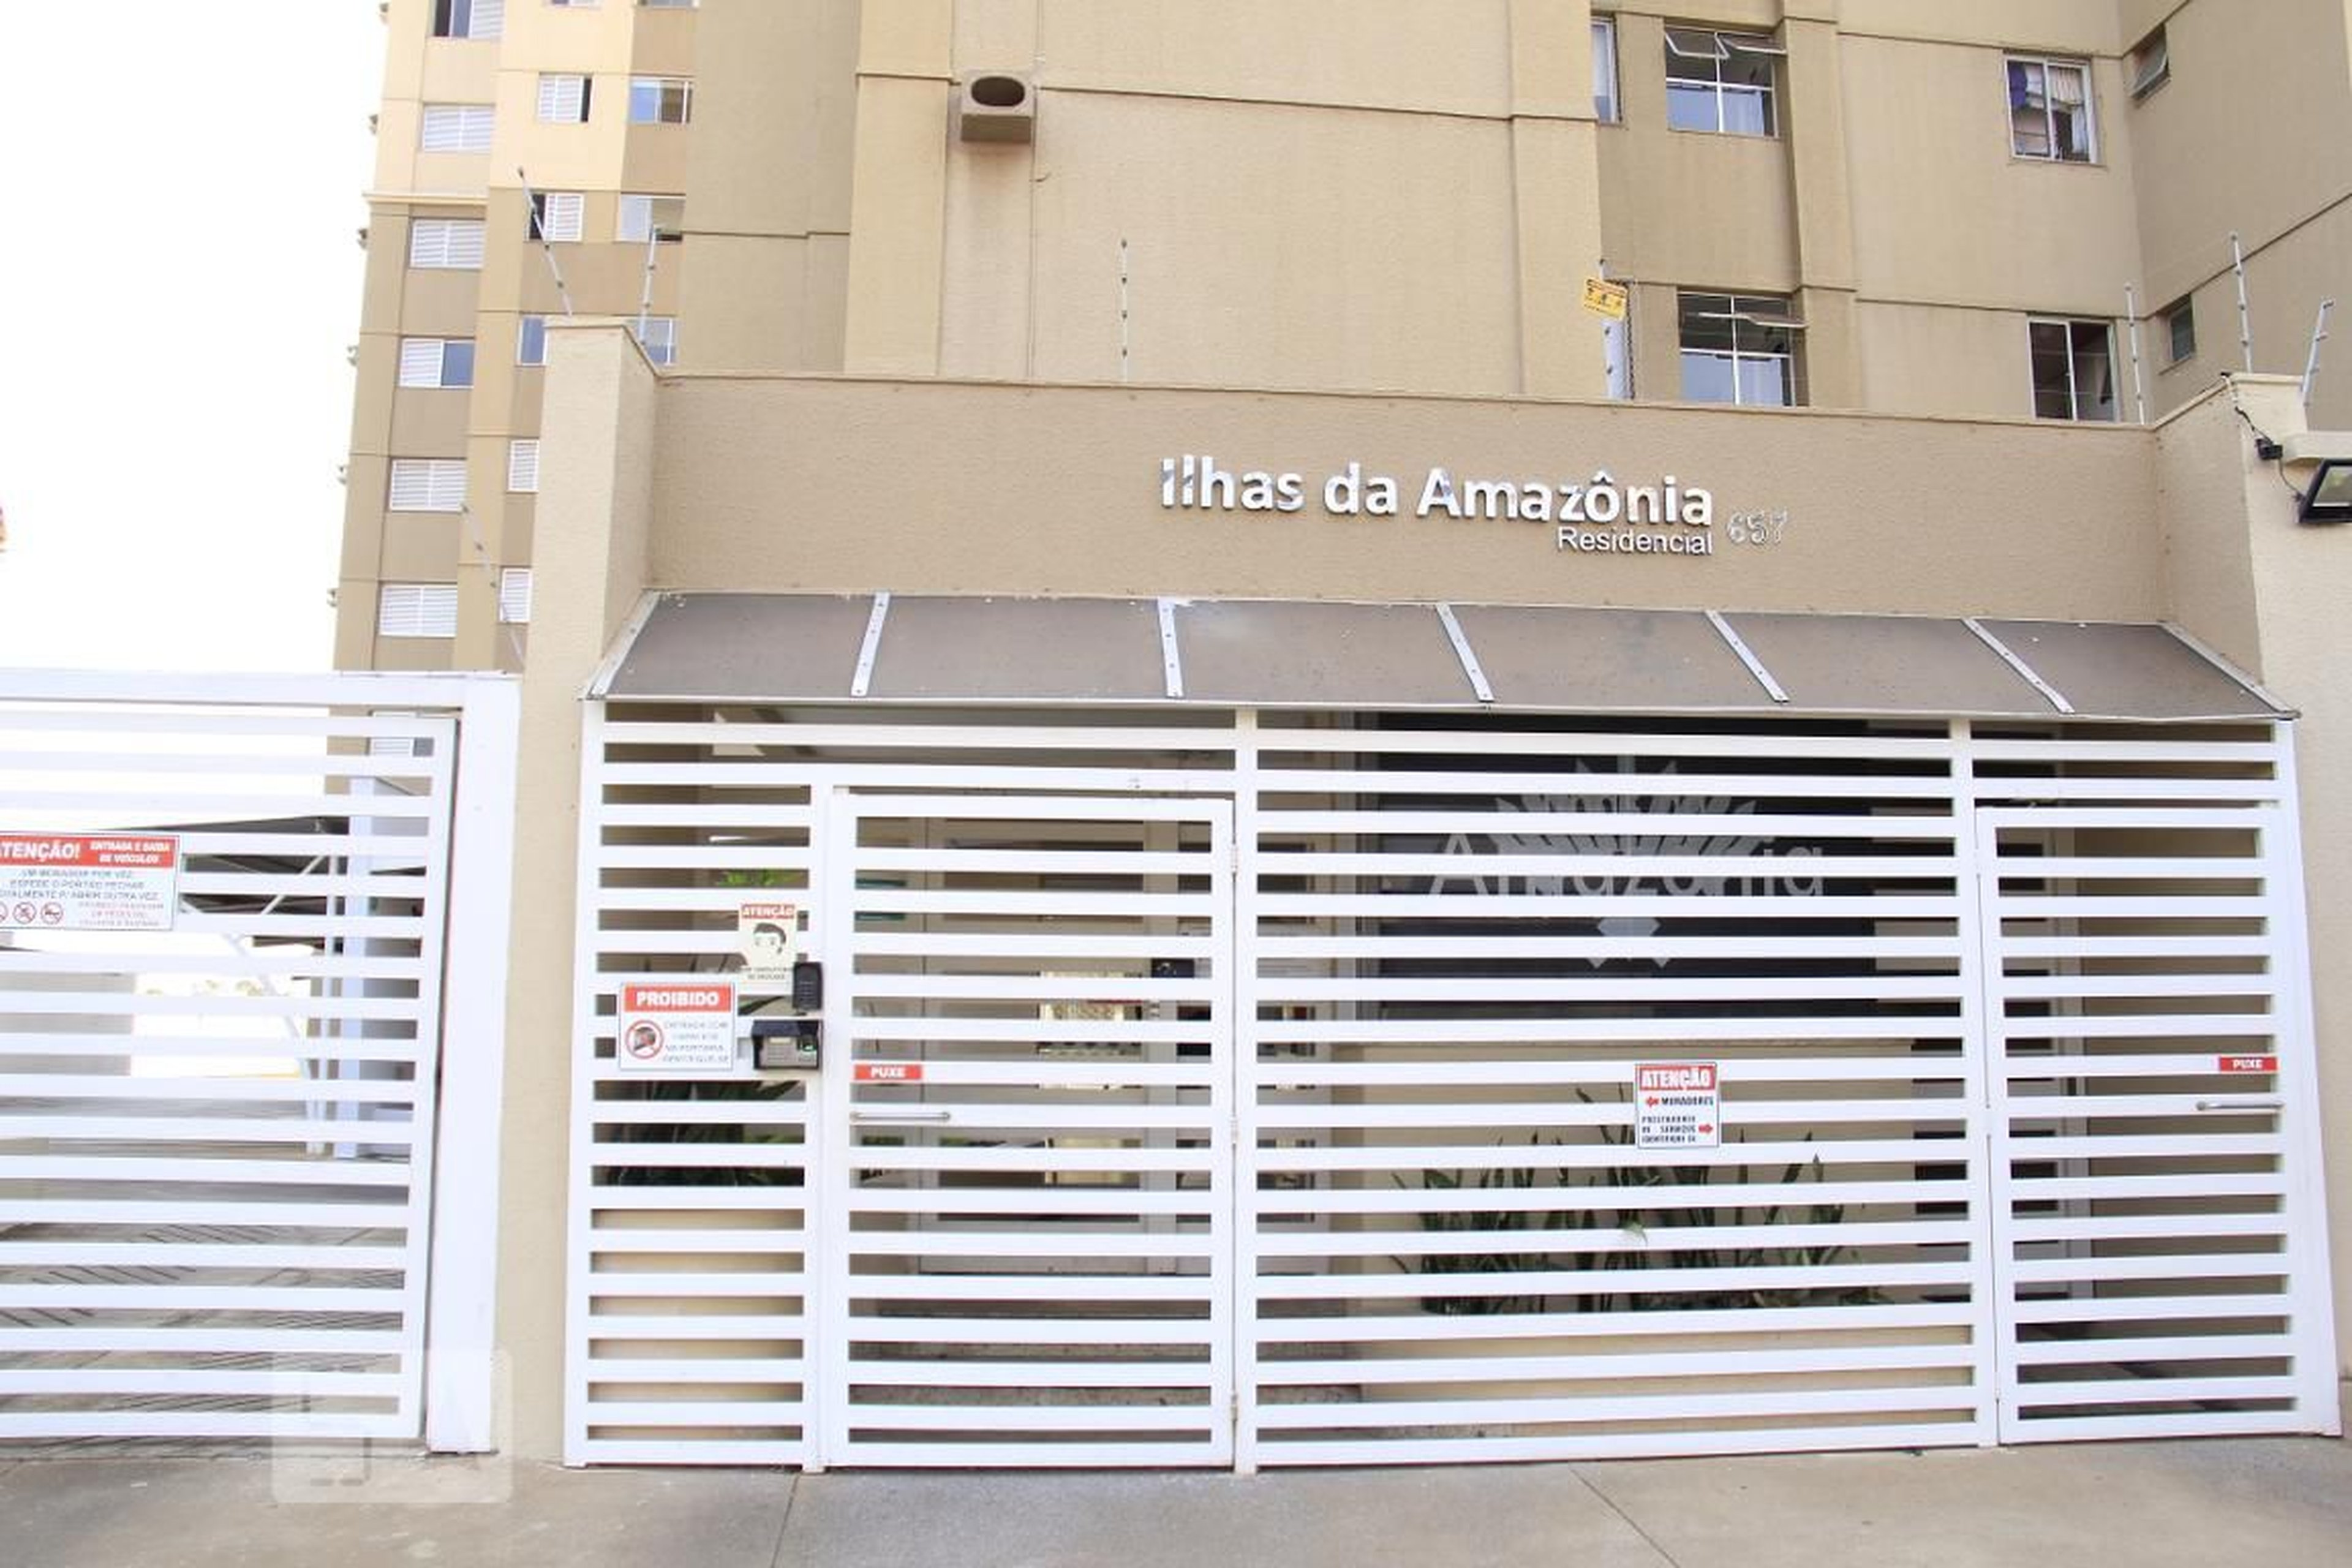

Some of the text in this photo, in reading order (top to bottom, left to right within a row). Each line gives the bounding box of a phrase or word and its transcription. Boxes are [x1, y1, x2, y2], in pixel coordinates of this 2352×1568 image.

[1162, 454, 1713, 526] Ilhas da Amazônia
[1727, 510, 1787, 545] 657
[1558, 527, 1713, 554] Residencial
[0, 840, 80, 862] TENÇÃO!
[742, 905, 794, 919] ATENÇÃO
[636, 991, 720, 1006] PROIBIDO
[870, 1066, 907, 1078] PUXE
[2233, 1059, 2263, 1069] PUXE
[1641, 1067, 1710, 1090] ATENÇÃO
[1662, 1096, 1714, 1106] MORADORES
